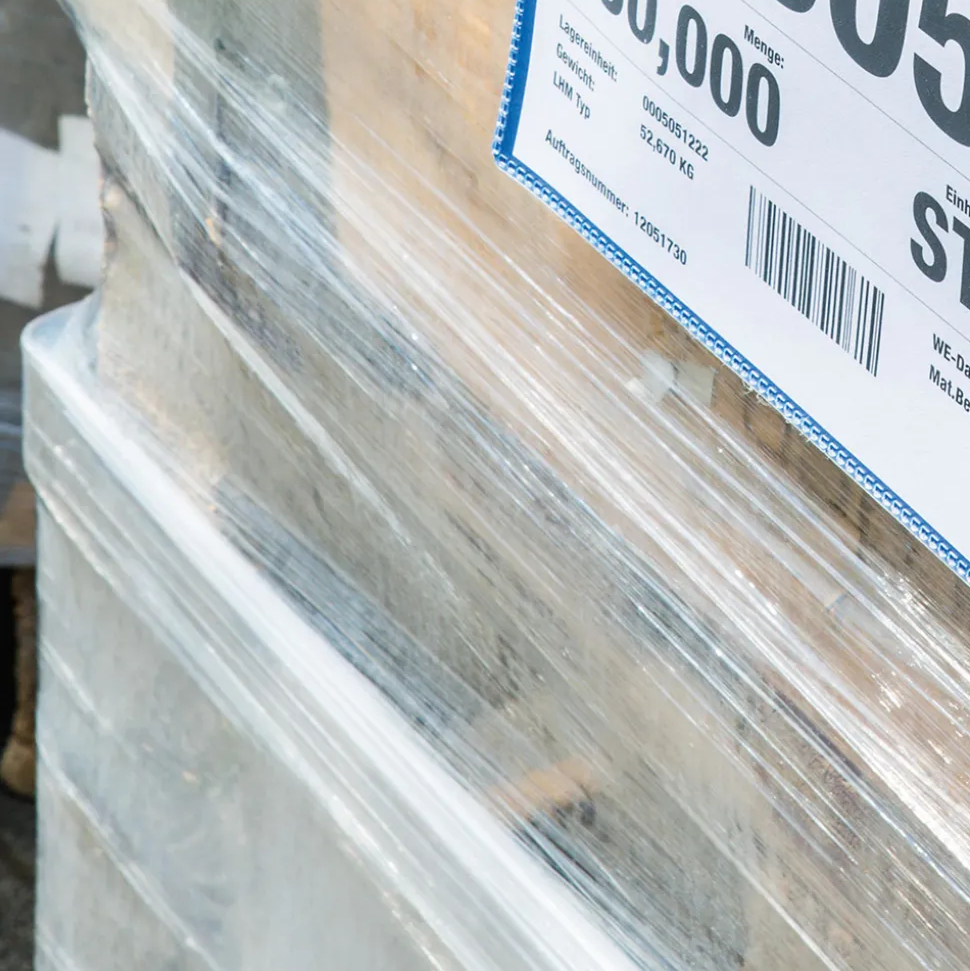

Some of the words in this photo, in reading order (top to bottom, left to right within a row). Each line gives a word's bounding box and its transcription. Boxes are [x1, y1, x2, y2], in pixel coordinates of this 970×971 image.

[556, 43, 595, 92] Gewicht:
[559, 14, 618, 82] Lagereinheit:
[744, 25, 785, 69] Menge:
[553, 71, 573, 104] LHM
[575, 93, 591, 120] Typ
[639, 125, 676, 166] 52,670
[679, 152, 695, 181] KG
[642, 95, 709, 162] 0005051222
[545, 129, 629, 217] Auftragsnummer:
[634, 212, 687, 266] 12051730
